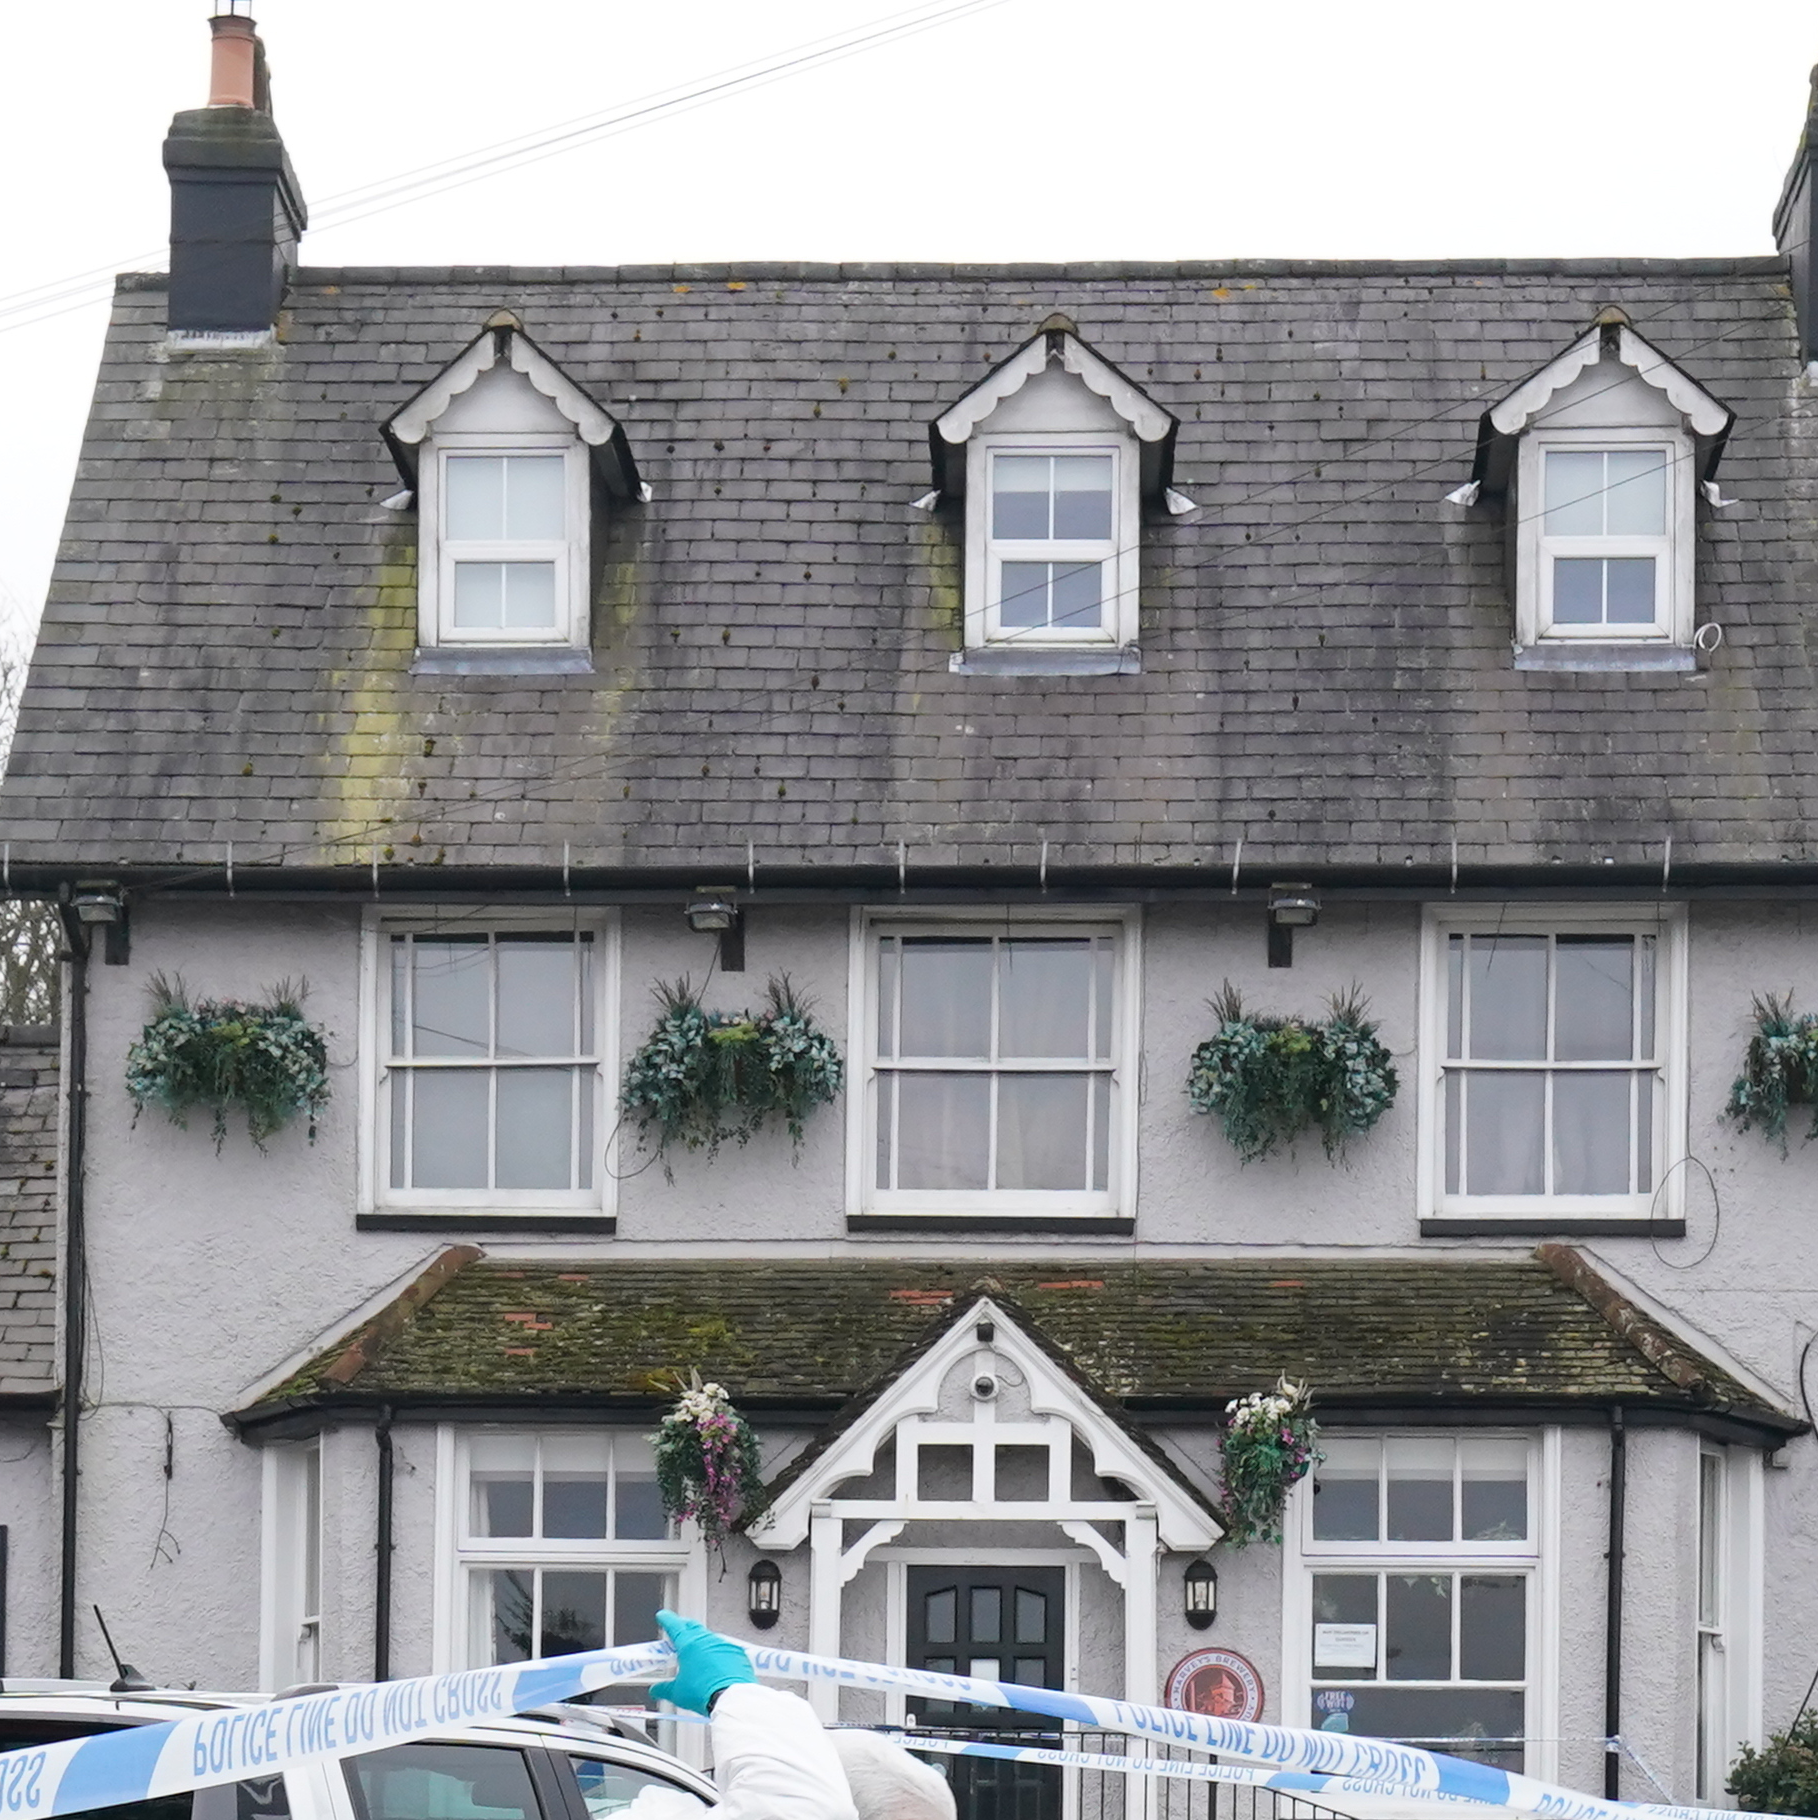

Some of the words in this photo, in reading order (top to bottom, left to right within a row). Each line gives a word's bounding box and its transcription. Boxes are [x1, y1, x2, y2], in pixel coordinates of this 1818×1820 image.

[1215, 1655, 1256, 1693] BREWERY
[1115, 1702, 1198, 1743] POLICE
[1206, 1719, 1256, 1755] LINE
[1263, 1726, 1296, 1763] DO
[1302, 1730, 1346, 1773] NOT
